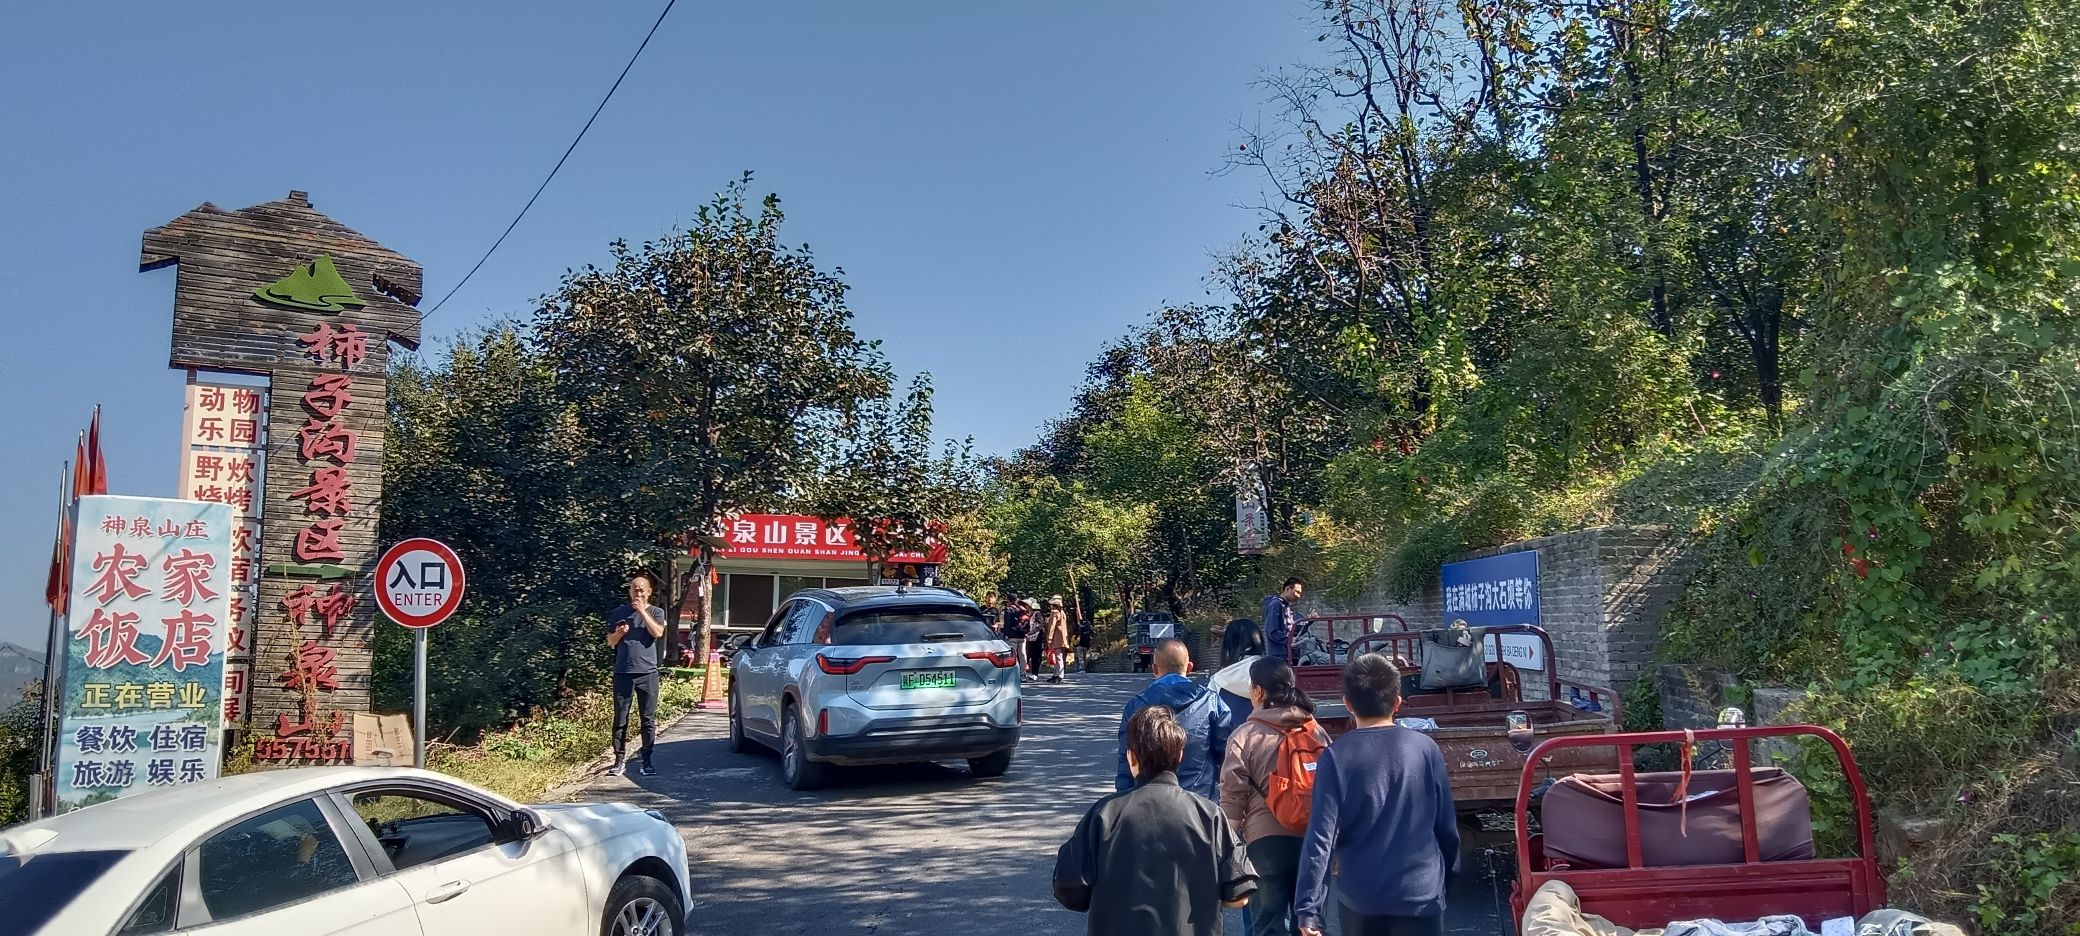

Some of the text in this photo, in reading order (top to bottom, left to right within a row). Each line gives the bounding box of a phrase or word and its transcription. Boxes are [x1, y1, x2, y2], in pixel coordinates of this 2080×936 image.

[199, 386, 260, 414] 动物
[197, 417, 257, 444] 乐园
[292, 322, 369, 560] 柿子沟景区
[194, 454, 255, 485] 野炊
[102, 513, 209, 539] 神泉山庄
[715, 519, 848, 546] 泉山景区
[82, 542, 219, 606] 农家
[389, 560, 446, 590] 入口
[394, 592, 443, 607] ENTER
[77, 608, 218, 672] 饭店
[80, 683, 207, 710] 正在营业
[75, 725, 207, 755] 餐饮 住宿
[73, 758, 206, 788] 旅游 娱乐
